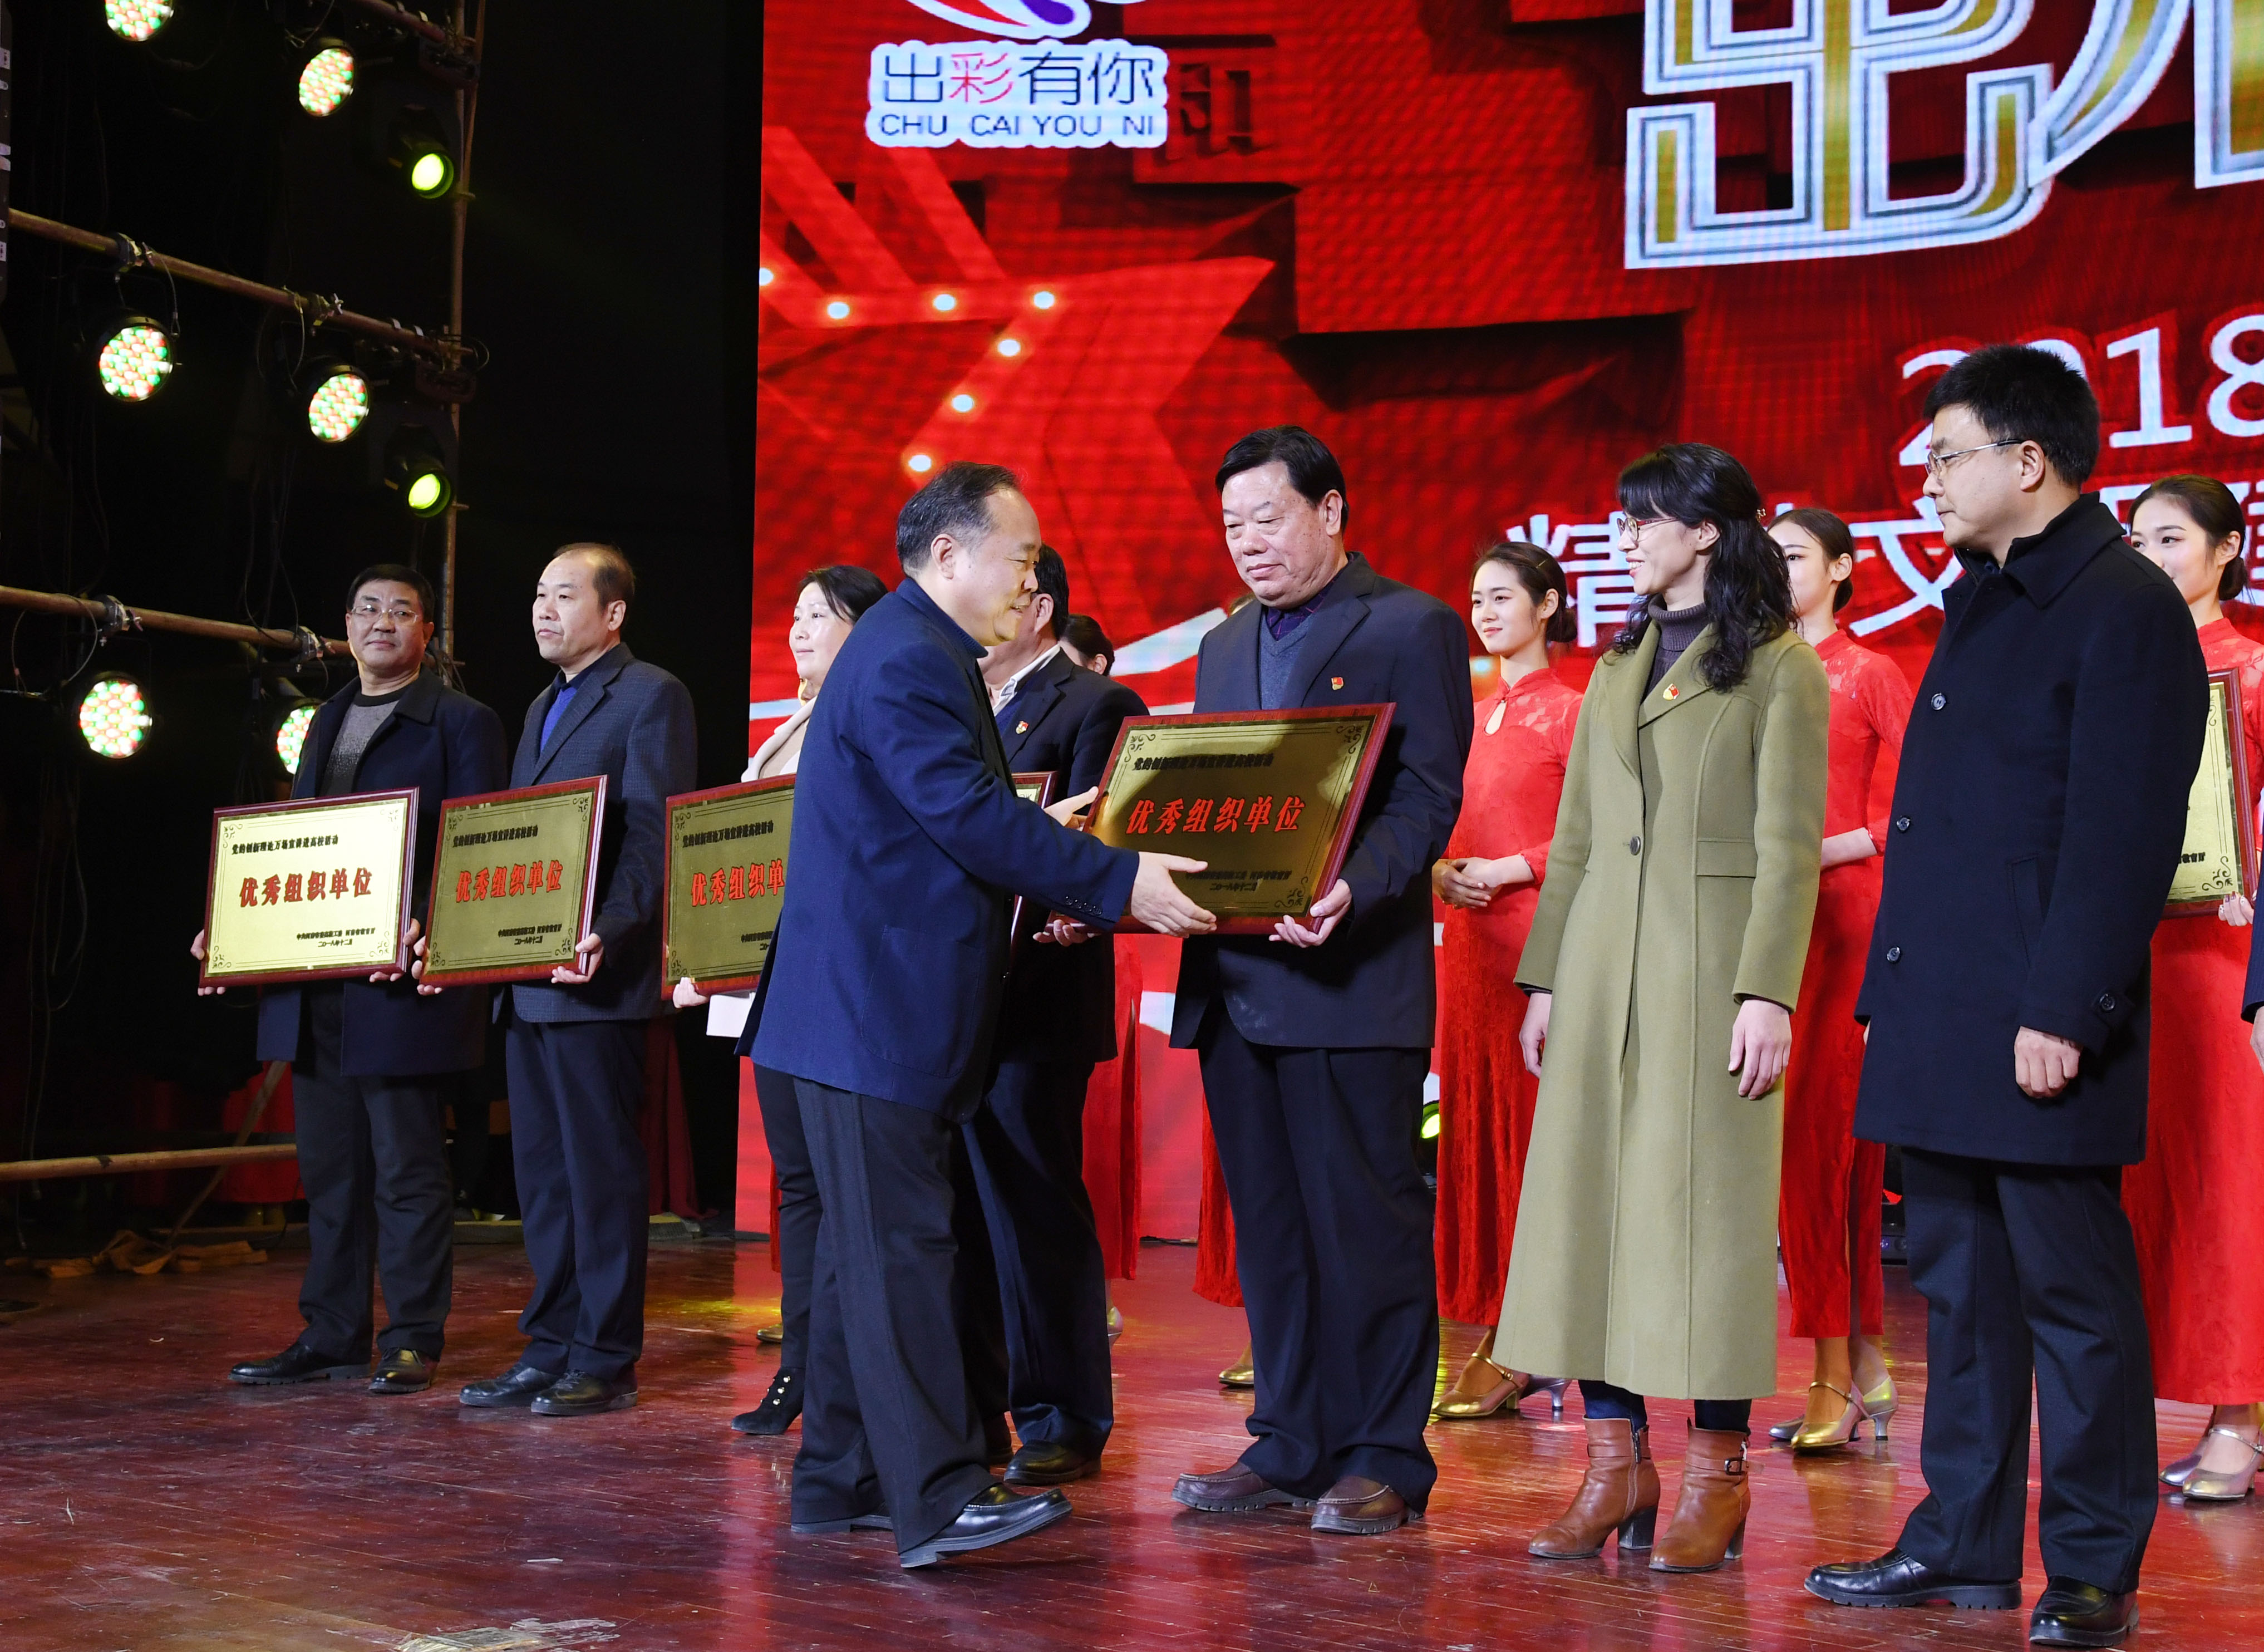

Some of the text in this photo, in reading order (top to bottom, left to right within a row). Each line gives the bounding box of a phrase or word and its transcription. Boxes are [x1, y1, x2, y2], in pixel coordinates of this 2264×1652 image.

[885, 51, 1153, 106] 出彩有你
[880, 114, 1153, 136] CHU CAI YOU NI
[1125, 795, 1305, 834] 优秀组织单位
[239, 867, 372, 907] 优秀组织单位
[456, 860, 563, 903] 优秀组织单位
